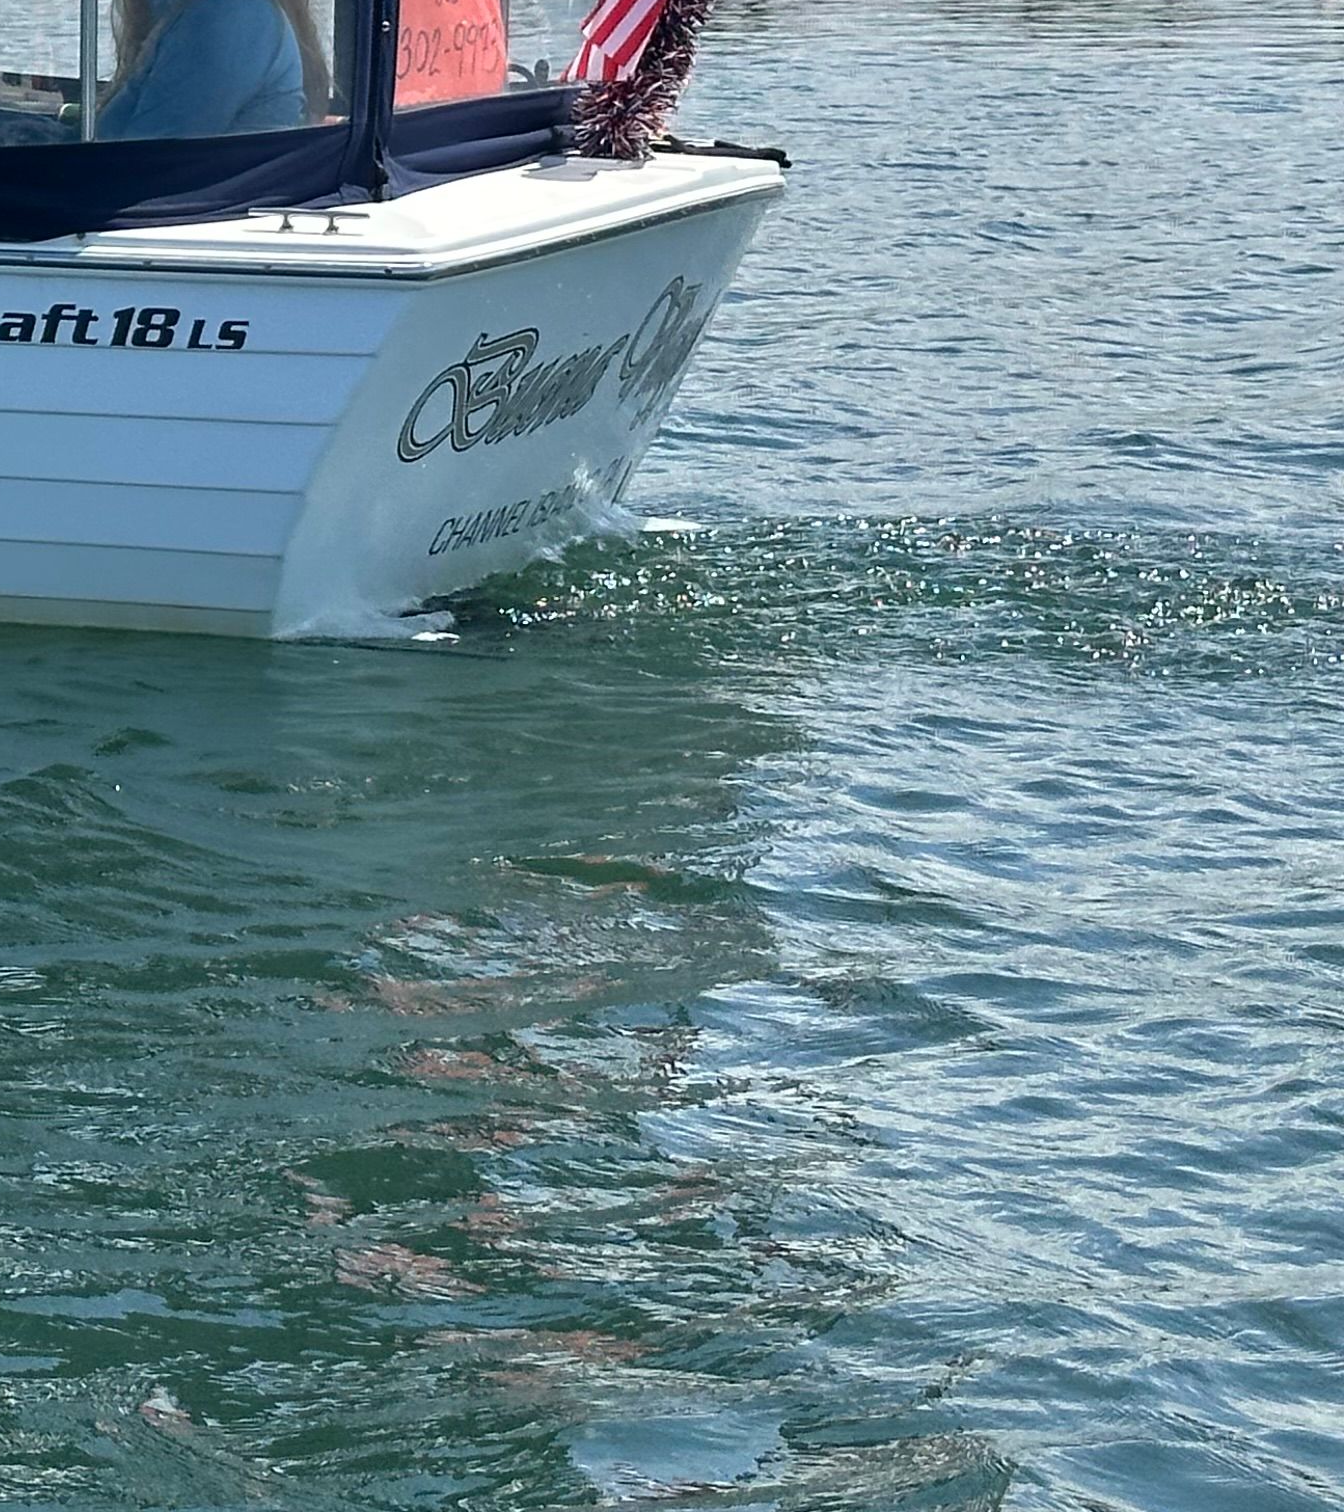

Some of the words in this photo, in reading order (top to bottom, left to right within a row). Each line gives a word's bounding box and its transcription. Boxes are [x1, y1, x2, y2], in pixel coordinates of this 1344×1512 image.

[110, 306, 181, 349] 18
[186, 318, 250, 351] LS
[427, 498, 531, 557] CHANNEL
